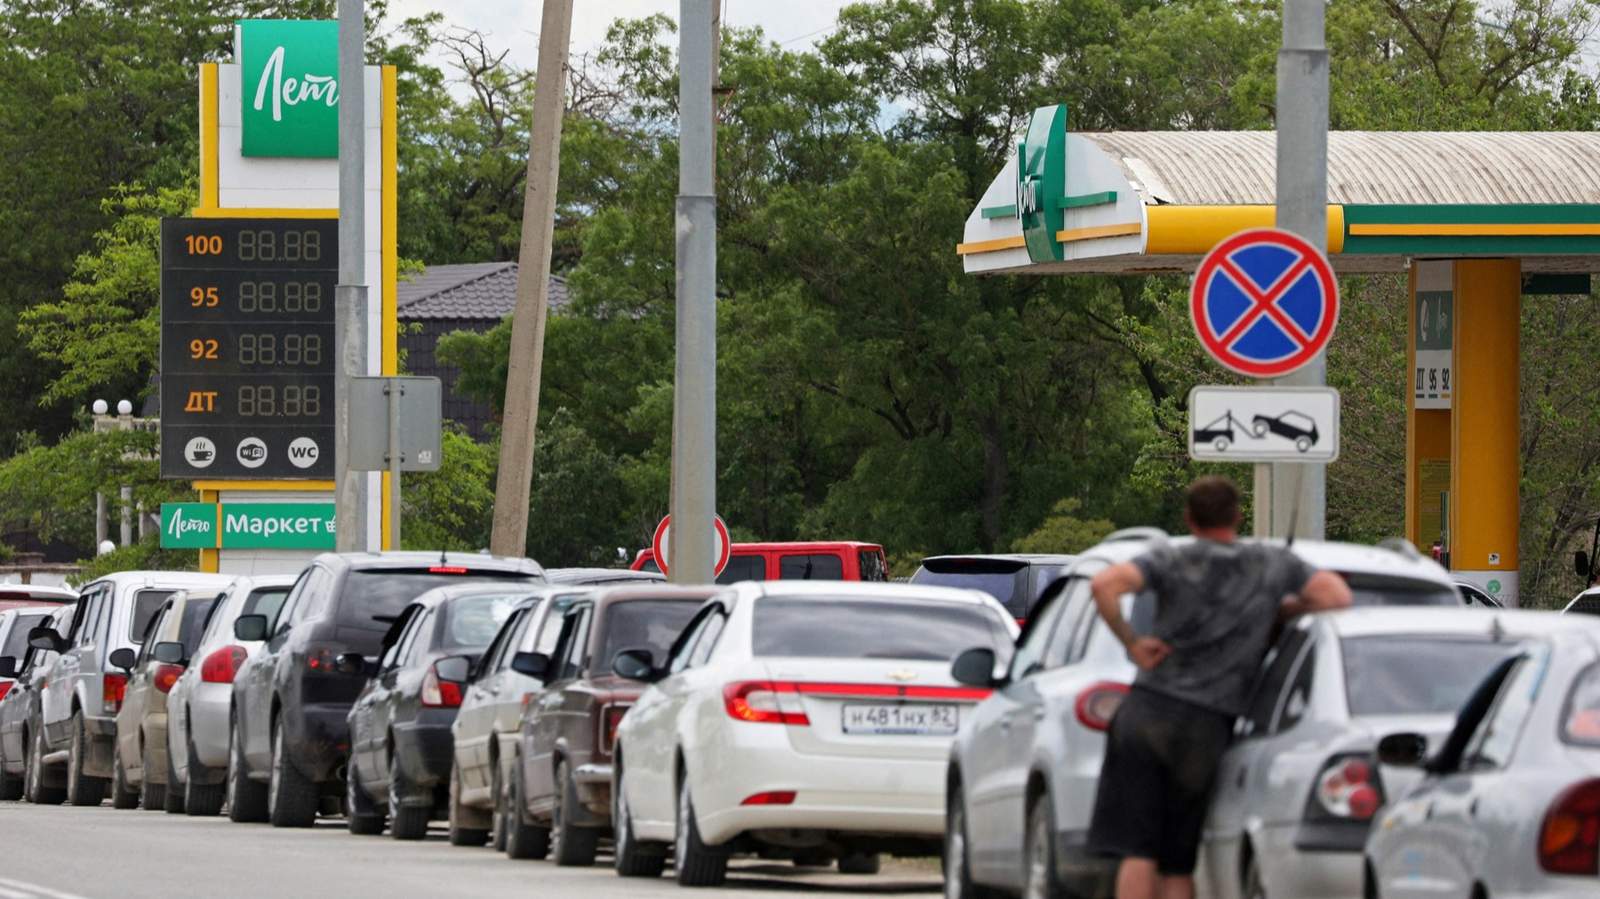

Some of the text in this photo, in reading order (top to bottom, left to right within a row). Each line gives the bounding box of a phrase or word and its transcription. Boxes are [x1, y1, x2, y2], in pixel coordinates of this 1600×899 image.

[185, 235, 223, 255] 100
[190, 287, 219, 307] 95
[190, 339, 219, 359] 92
[184, 391, 218, 412] ДТ
[291, 446, 317, 458] WC
[225, 513, 322, 538] Маркет
